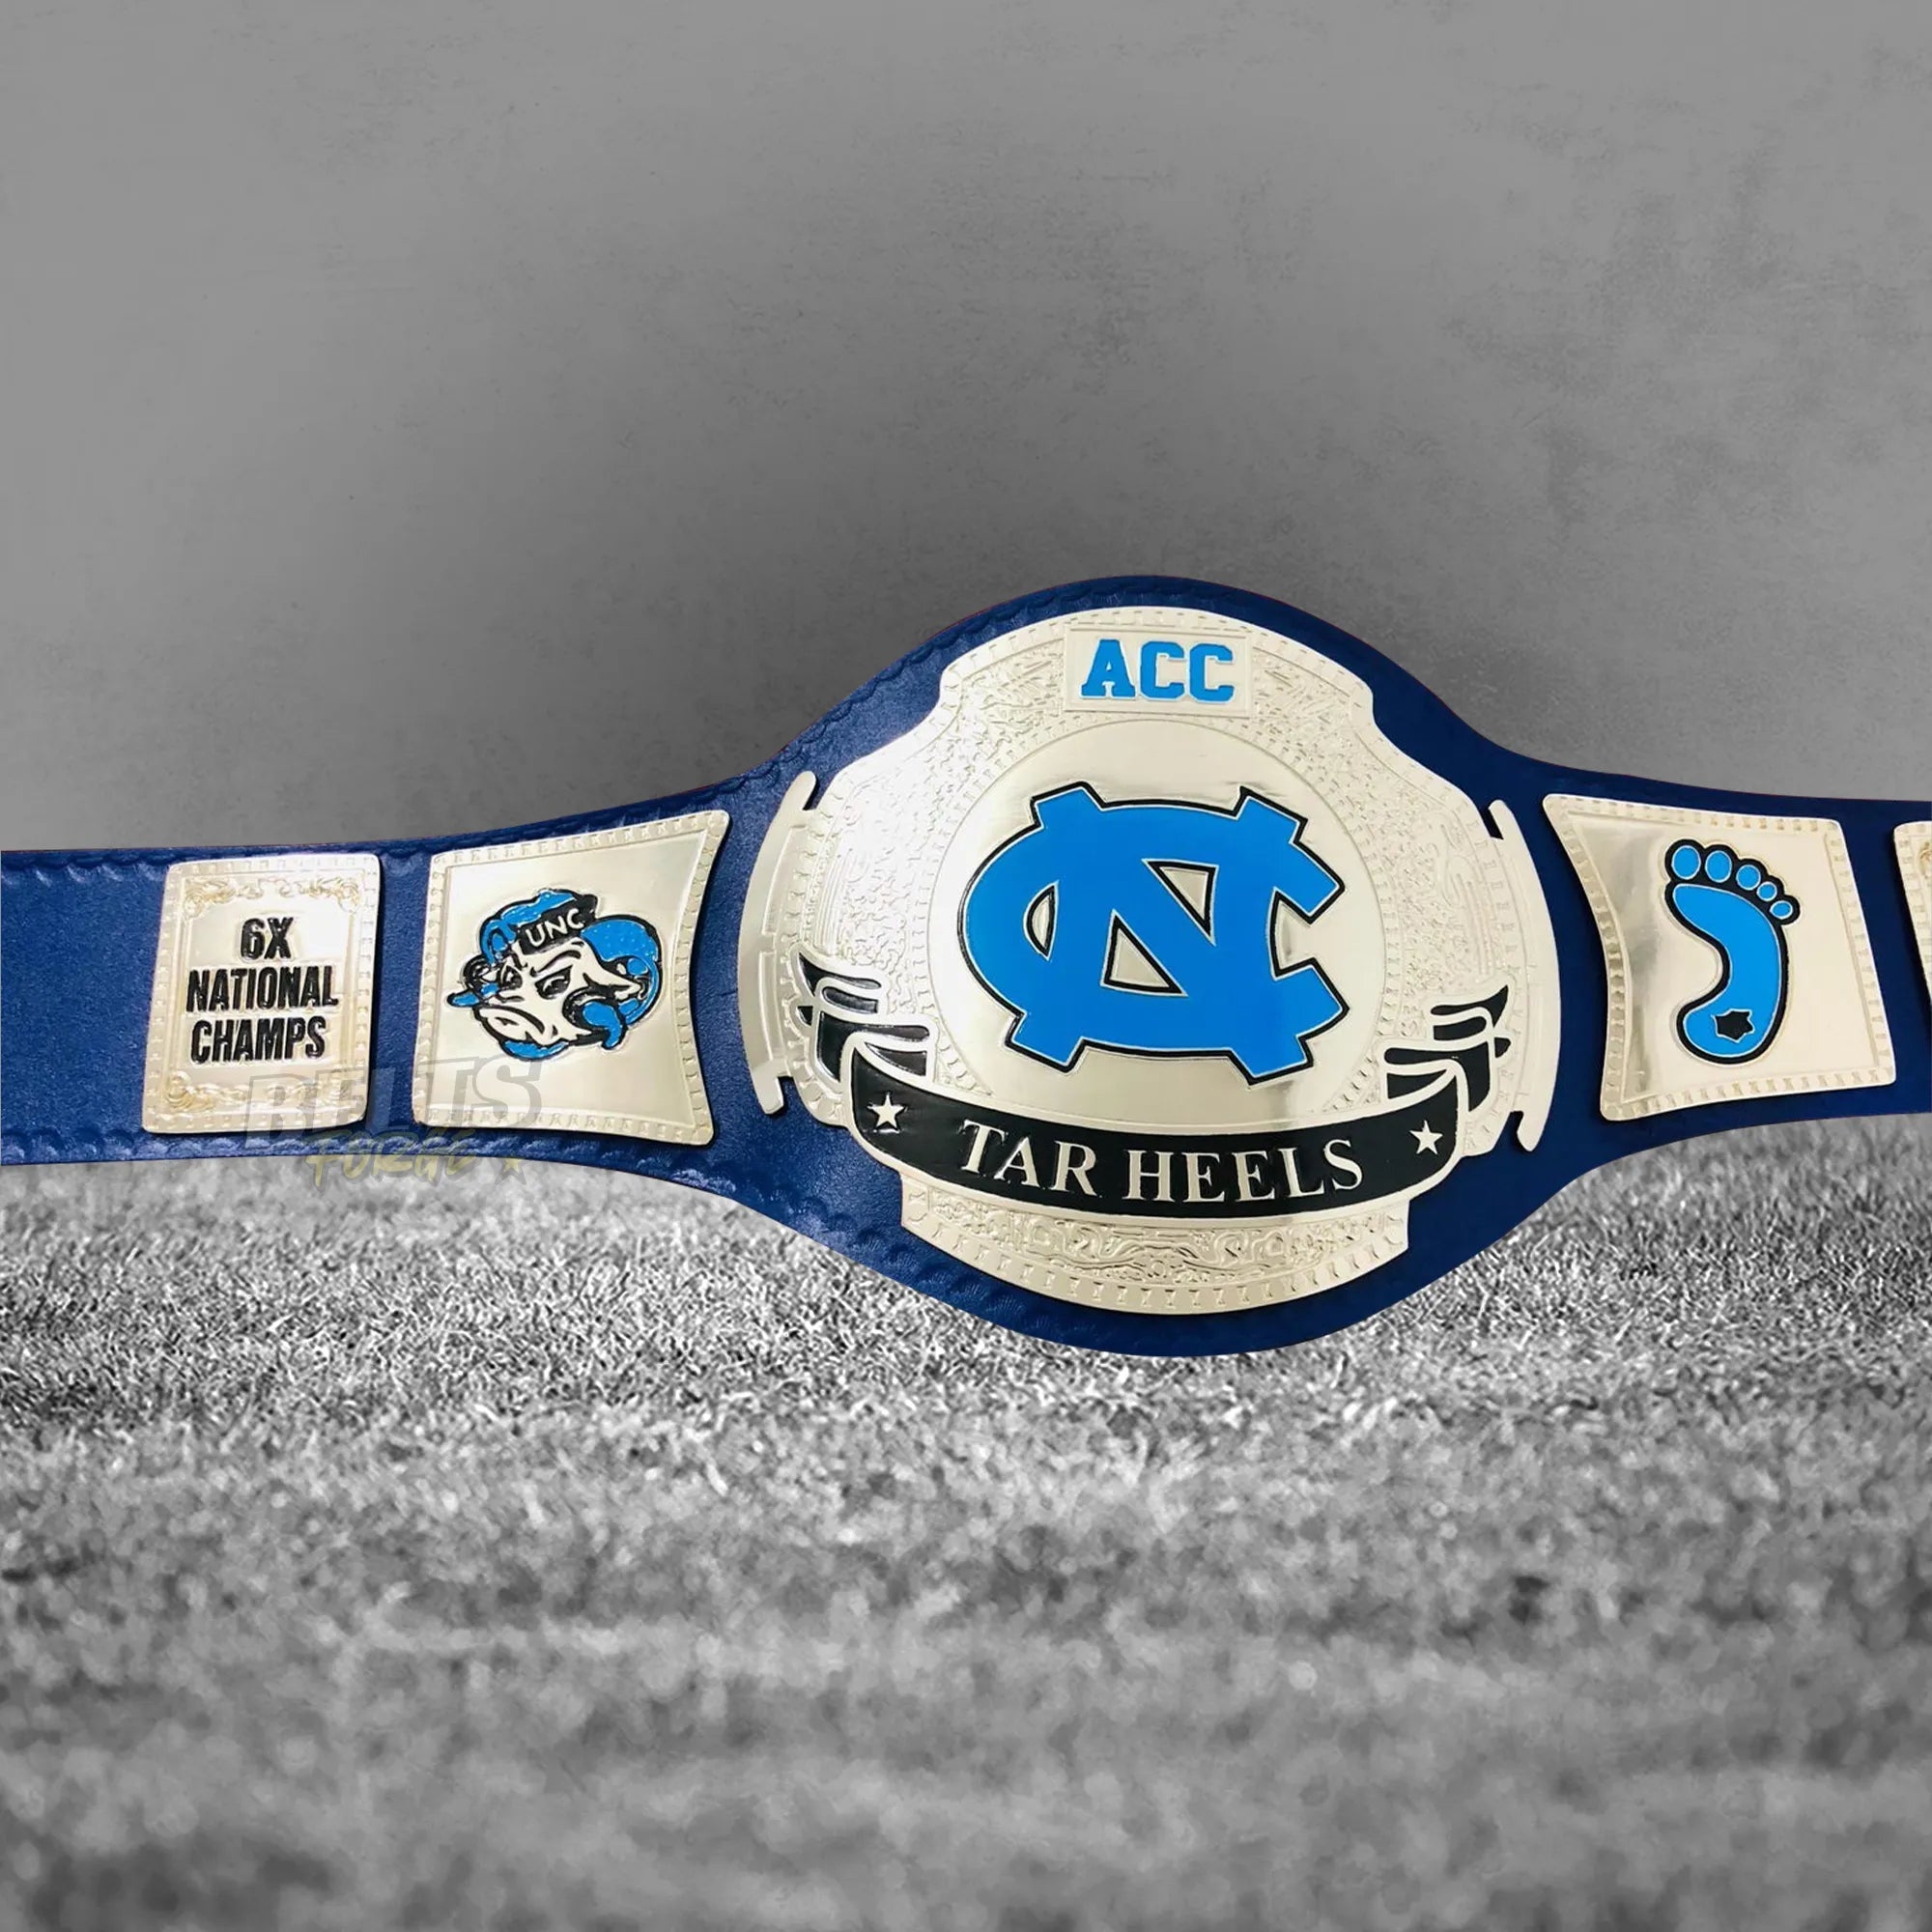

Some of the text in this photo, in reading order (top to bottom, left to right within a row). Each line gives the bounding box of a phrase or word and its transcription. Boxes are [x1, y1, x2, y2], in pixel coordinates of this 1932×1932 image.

[1081, 639, 1235, 702] ACC
[240, 917, 294, 959] 6X
[525, 906, 584, 948] UNC
[185, 966, 339, 1012] NATIONAL
[191, 1015, 327, 1064] CHAMPS
[960, 1119, 1363, 1203] TAR HEELS
